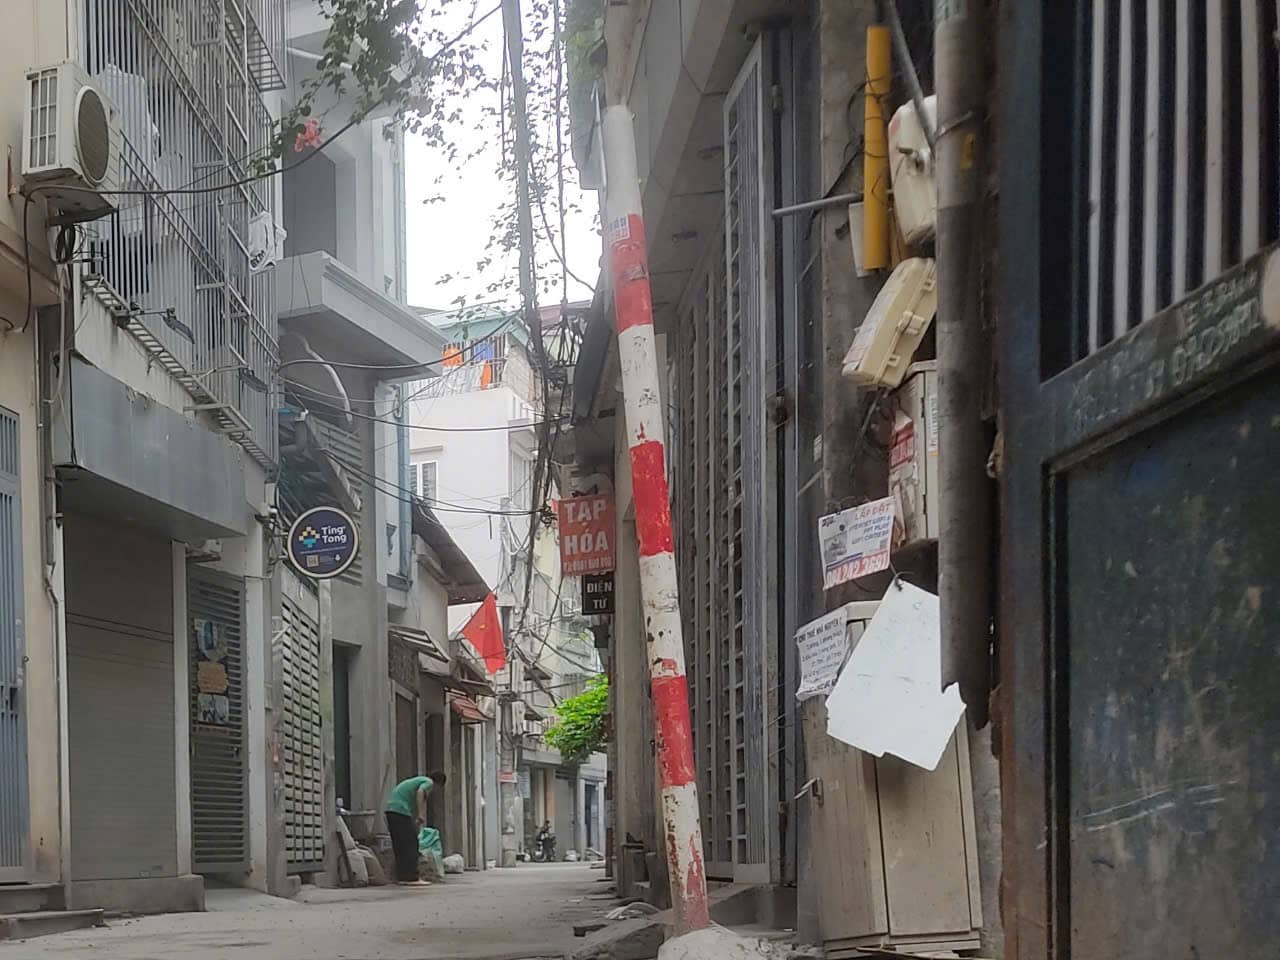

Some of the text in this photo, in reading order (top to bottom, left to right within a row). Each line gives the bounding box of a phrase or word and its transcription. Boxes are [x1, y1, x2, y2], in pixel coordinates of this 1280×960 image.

[564, 499, 607, 526] TẠP
[321, 525, 346, 535] Ting
[321, 534, 347, 543] Tong
[564, 527, 609, 555] HÓA
